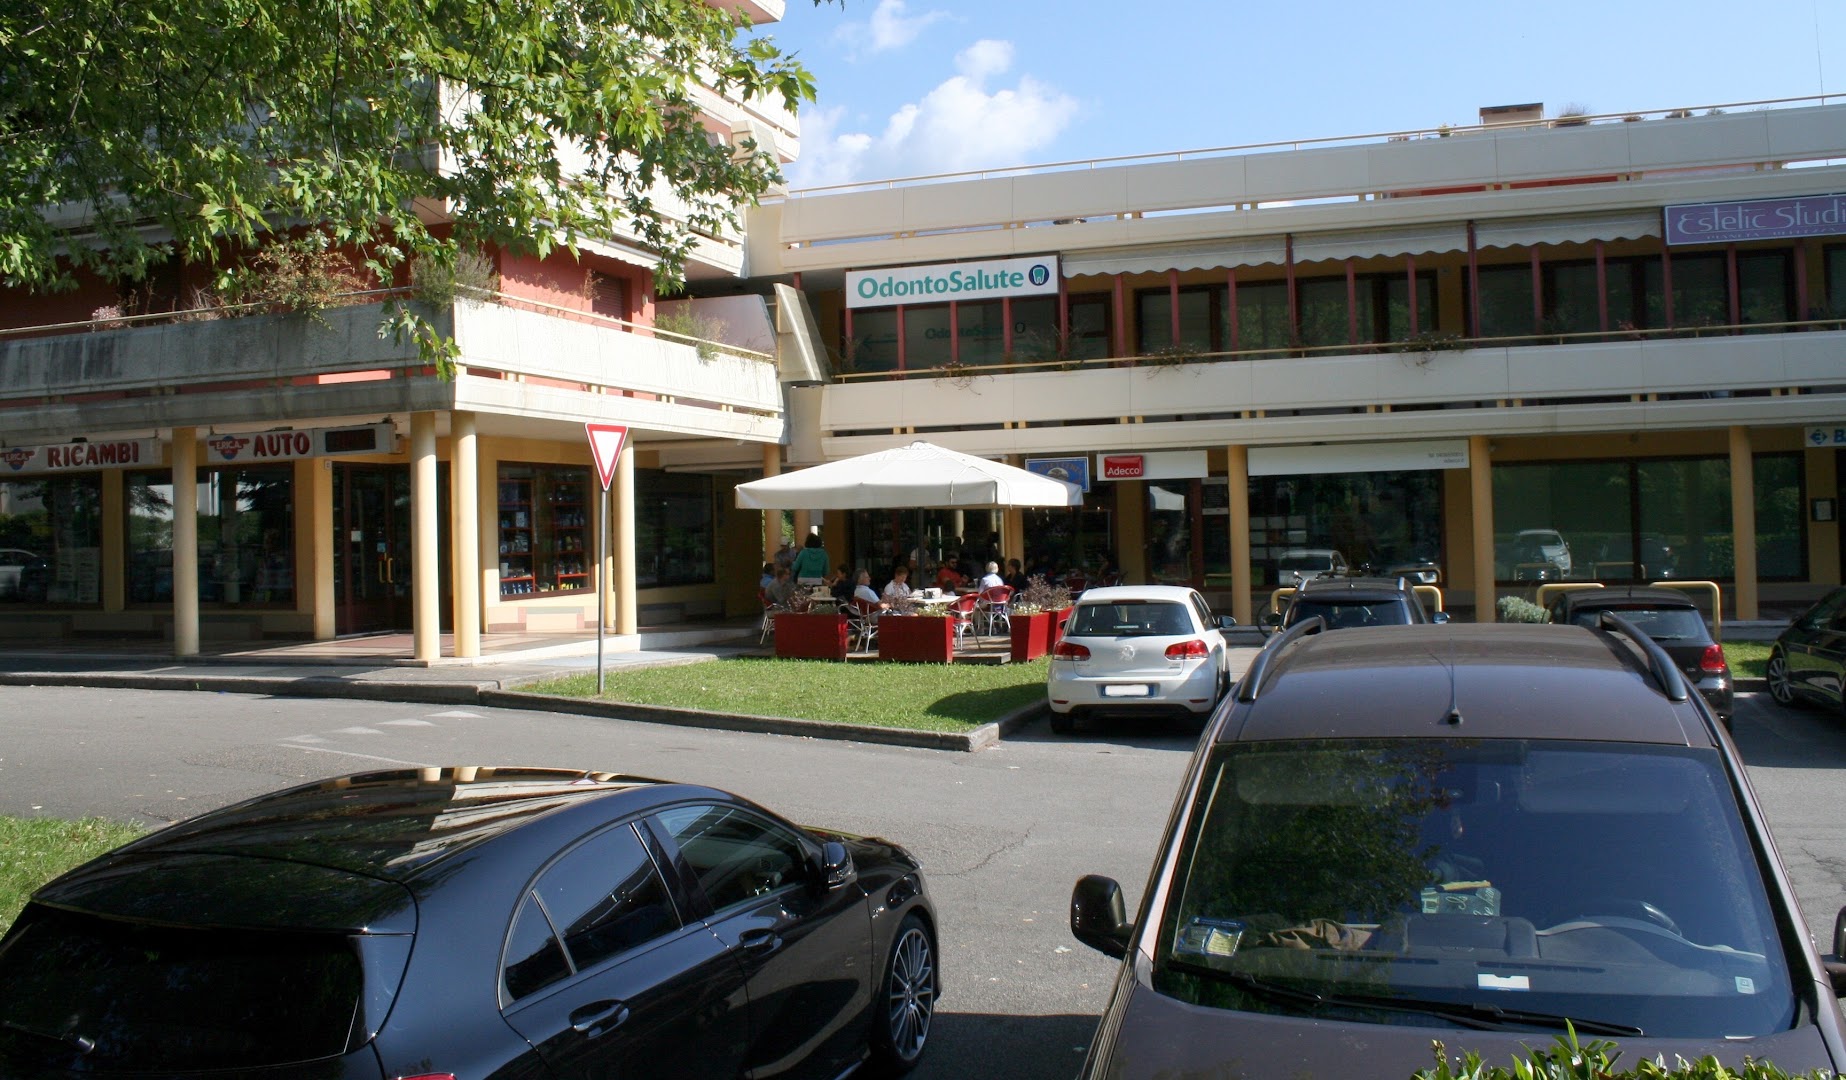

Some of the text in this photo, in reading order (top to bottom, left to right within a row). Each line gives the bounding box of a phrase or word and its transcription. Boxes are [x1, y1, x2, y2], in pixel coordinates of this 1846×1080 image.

[857, 269, 1024, 299] OdontoSalute
[47, 442, 139, 468] RICAMBI
[253, 432, 310, 457] AUTO
[1107, 466, 1140, 476] Adecco
